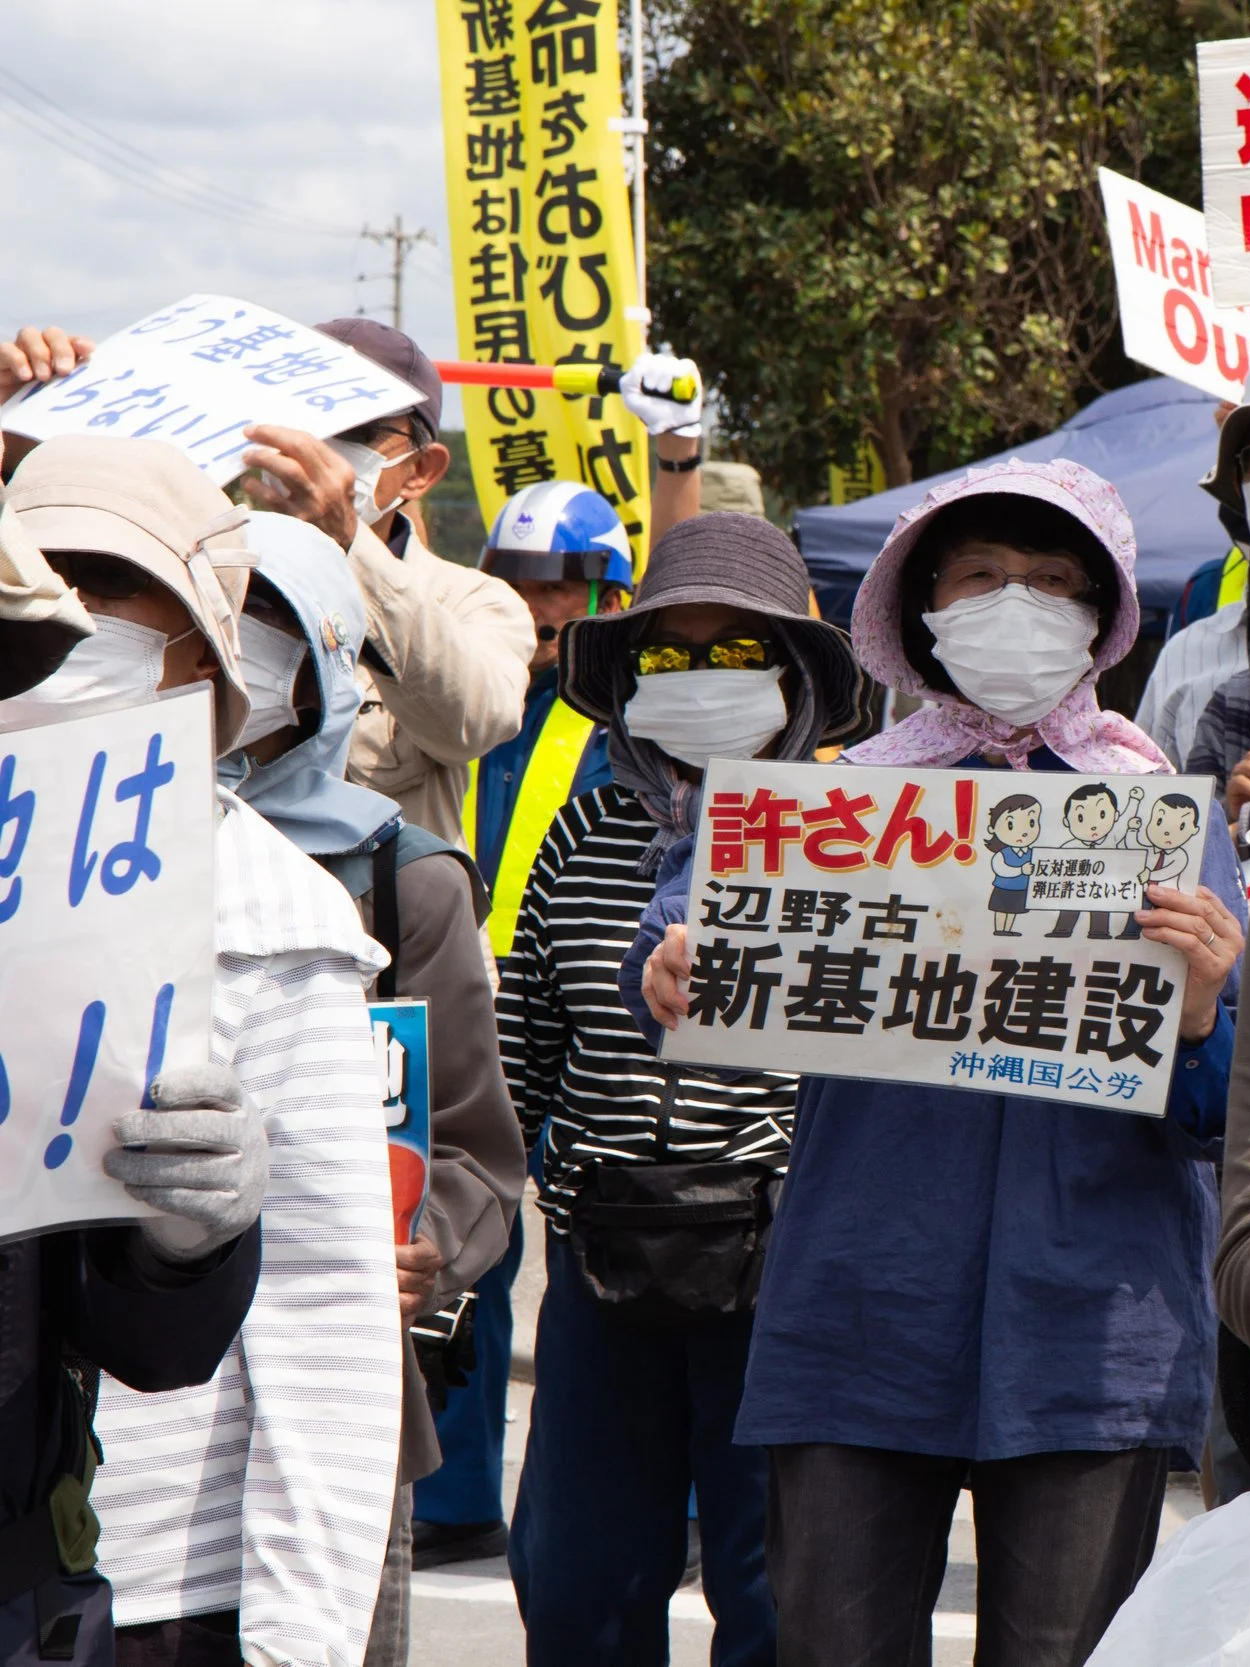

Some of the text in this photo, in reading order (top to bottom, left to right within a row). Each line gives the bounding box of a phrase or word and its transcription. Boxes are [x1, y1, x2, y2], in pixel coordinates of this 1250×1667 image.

[708, 779, 979, 877] 許さん!
[1032, 880, 1137, 900] 弾圧許さないぞ!
[1035, 858, 1106, 877] 反対運動の
[699, 880, 930, 943] 辺野古
[687, 937, 1175, 1068] 新基地建設
[948, 1050, 1143, 1100] 沖縄国公労
